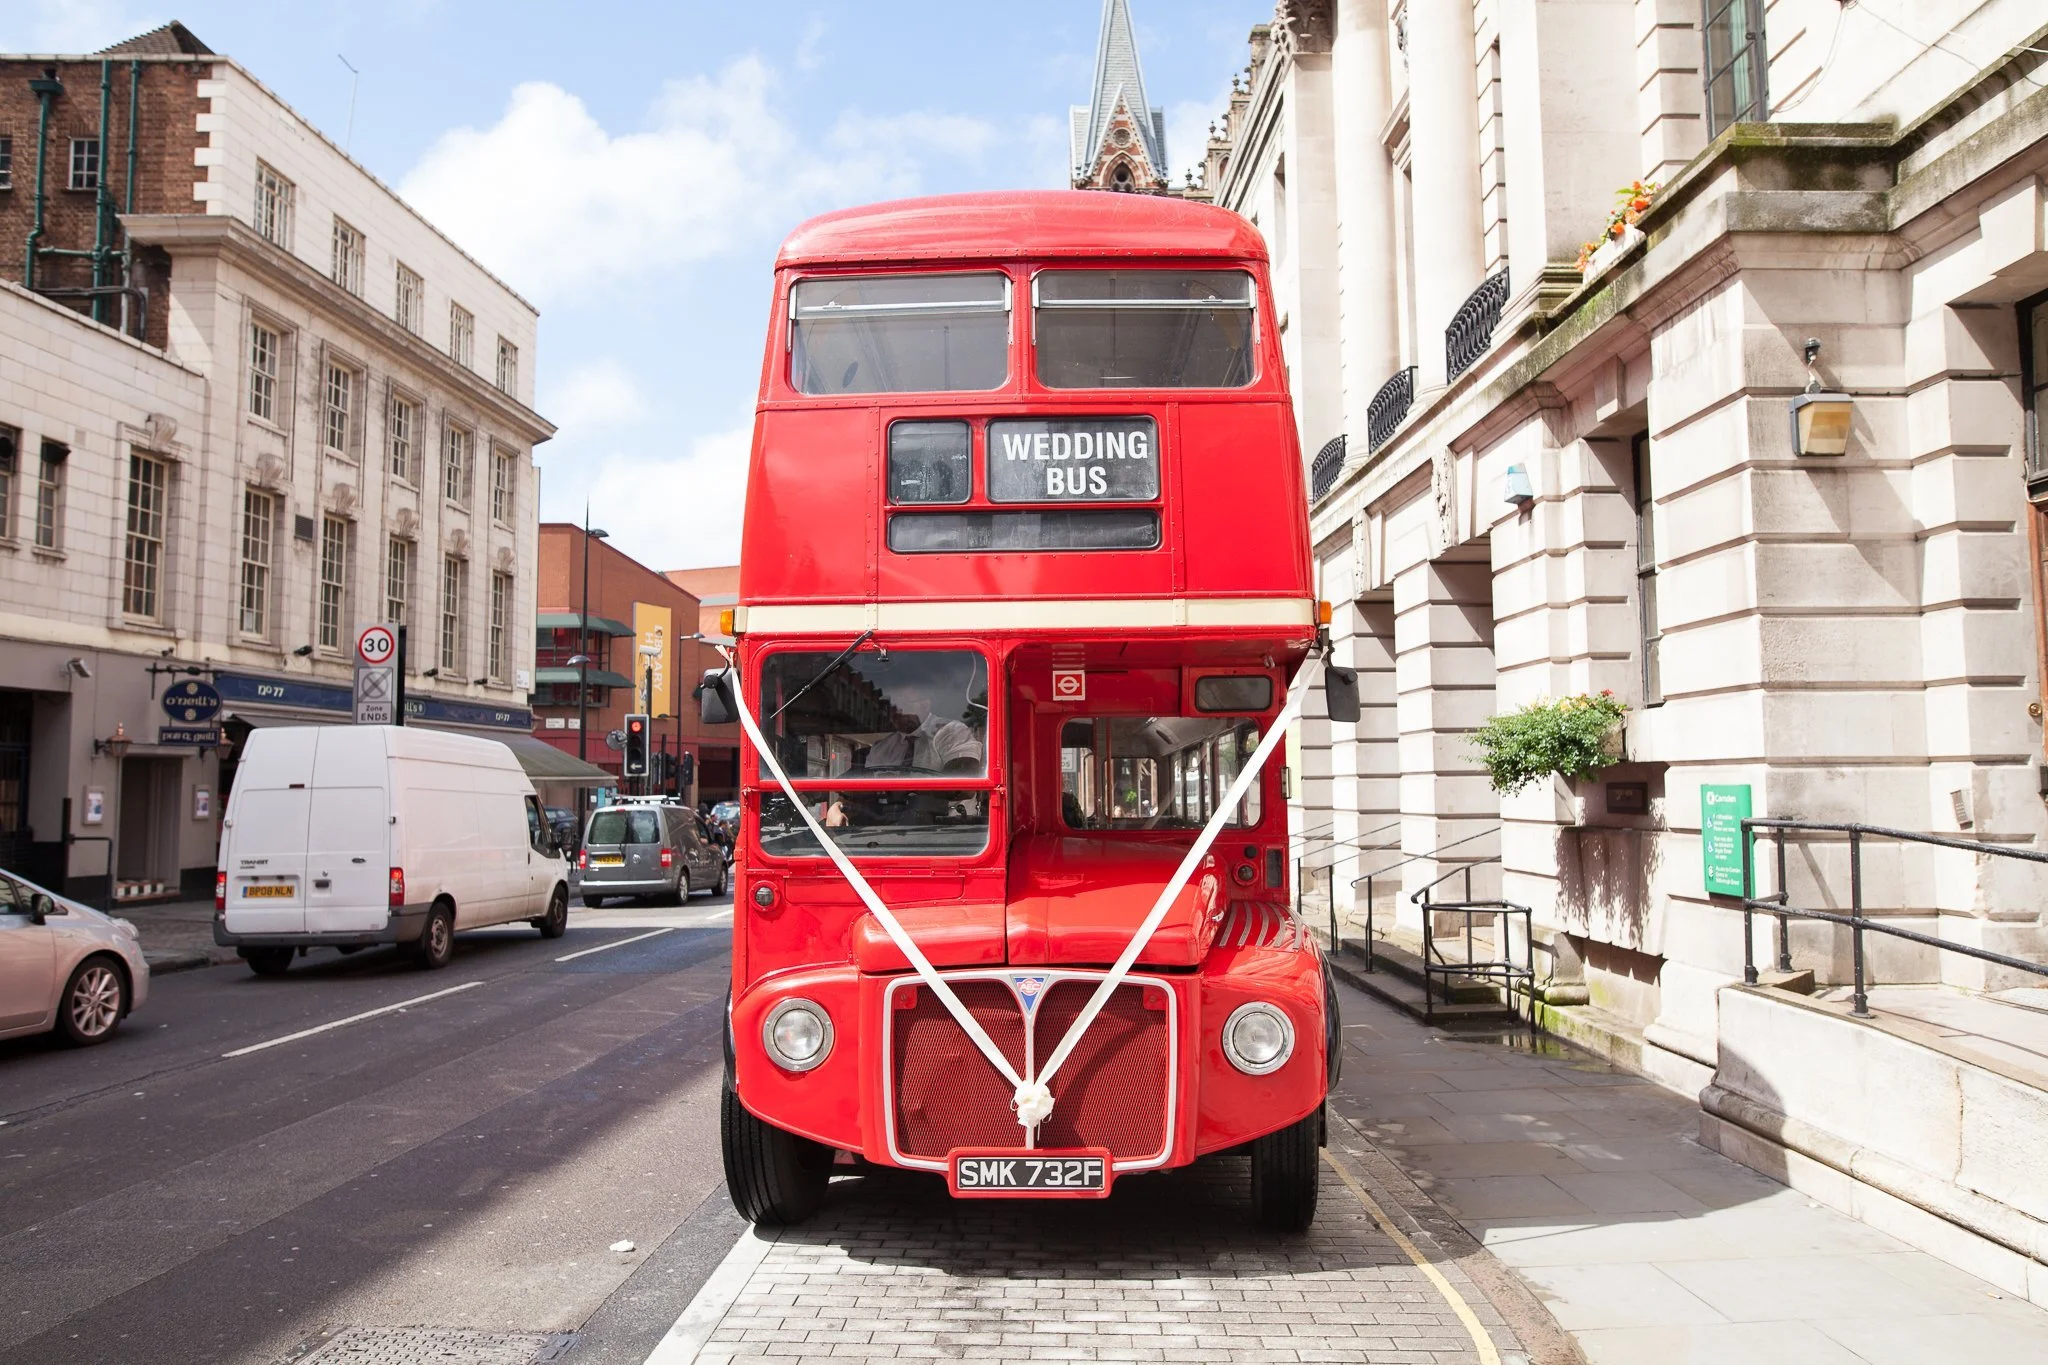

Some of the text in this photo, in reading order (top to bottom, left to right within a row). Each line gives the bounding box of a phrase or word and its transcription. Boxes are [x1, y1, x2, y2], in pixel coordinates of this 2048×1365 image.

[1003, 431, 1149, 461] WEDDING
[1046, 466, 1108, 495] BUS
[364, 637, 390, 653] 30
[365, 704, 383, 712] Zone
[360, 713, 388, 721] ENDS
[1020, 983, 1041, 991] AEC
[960, 1160, 1102, 1186] SMK 732F
